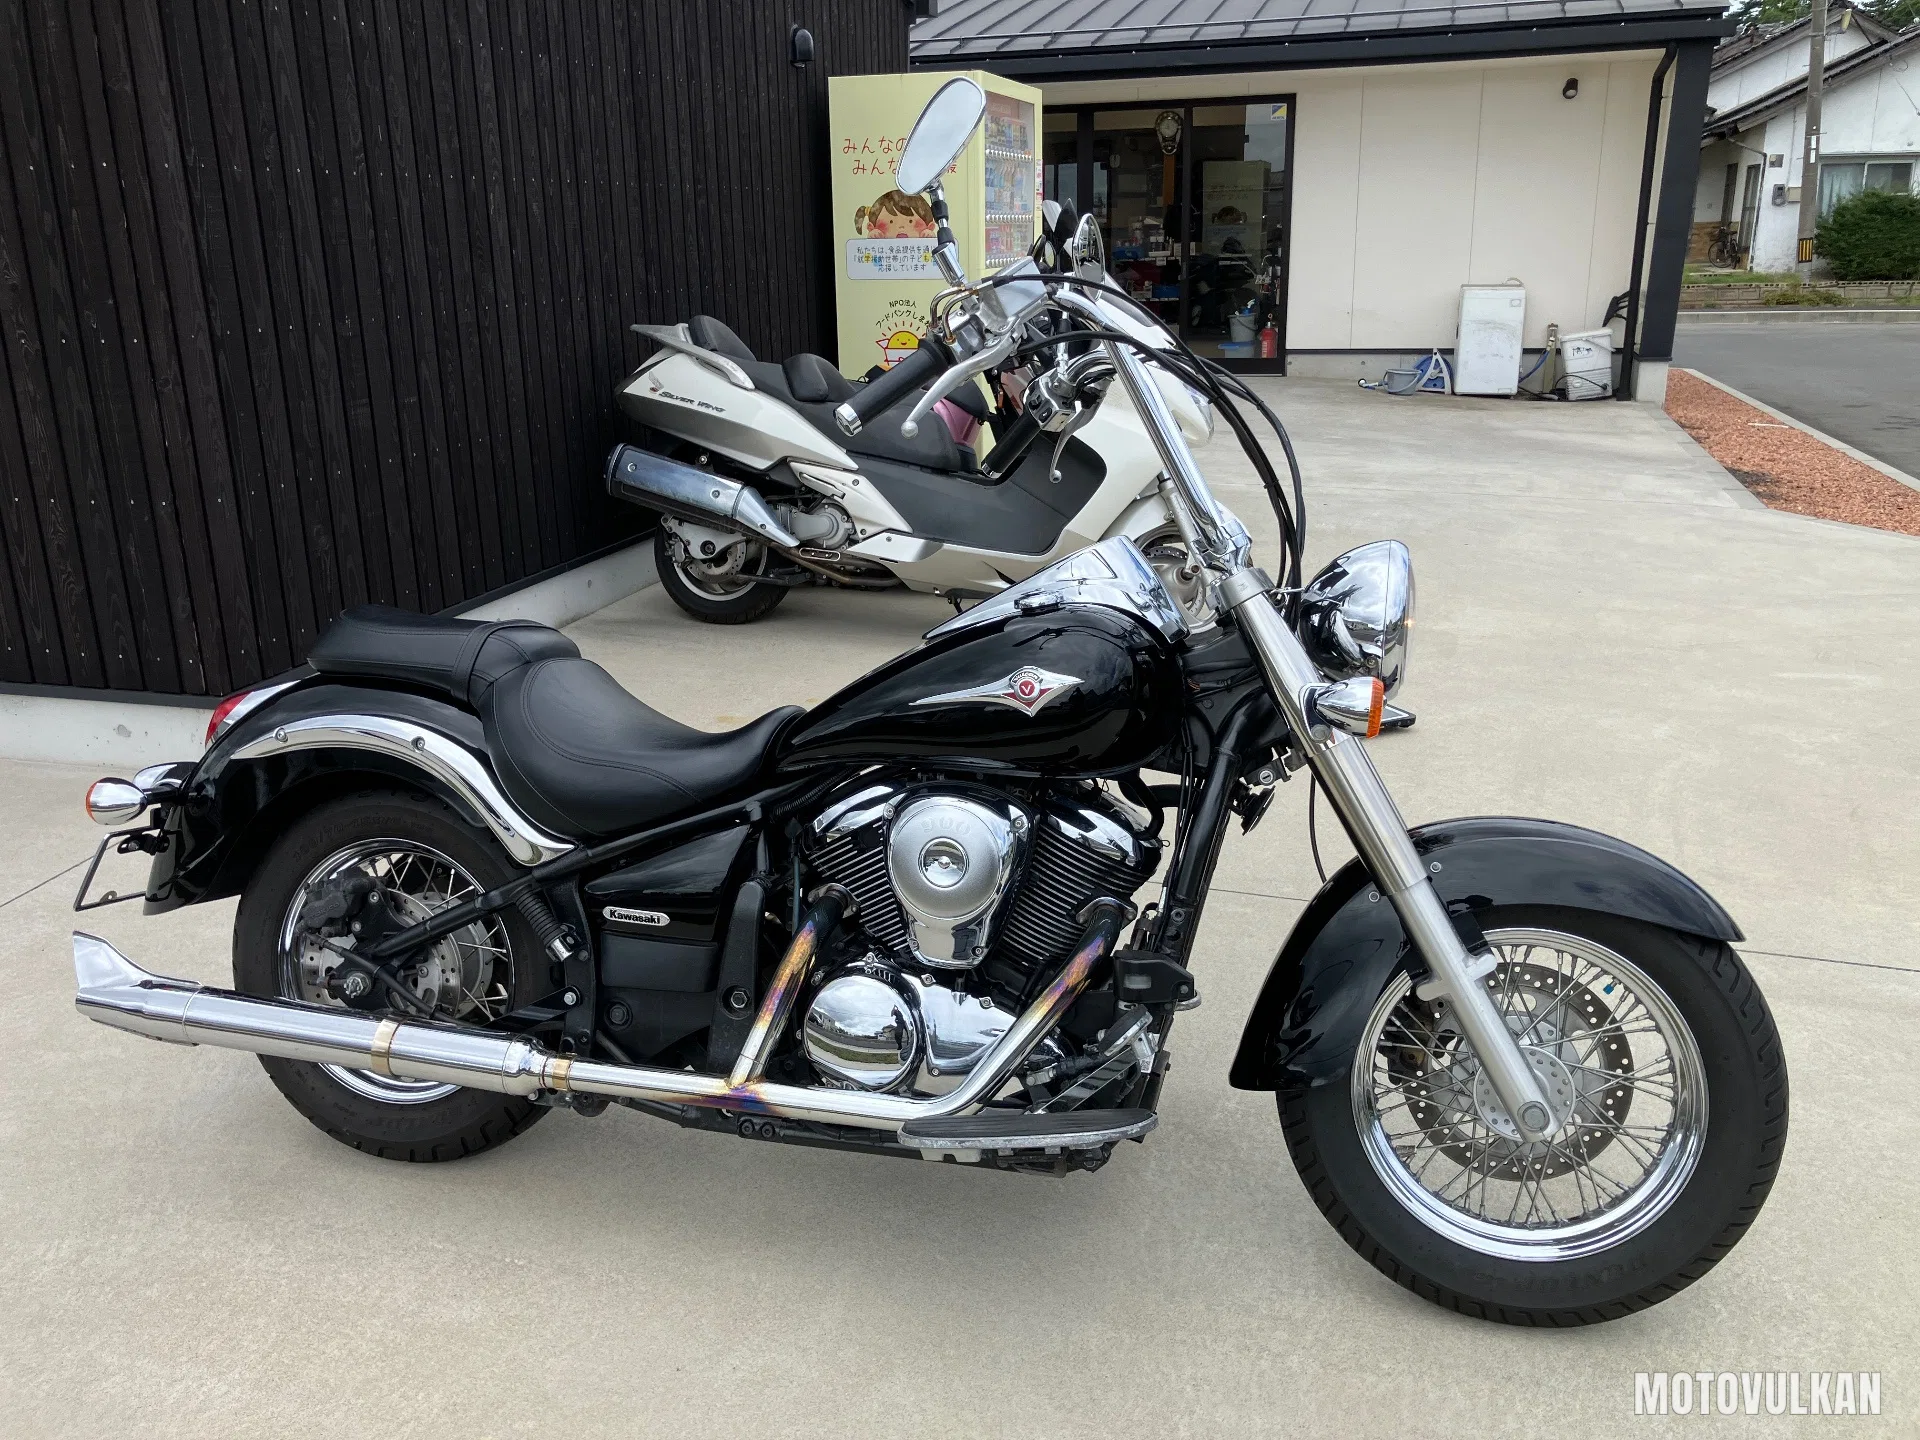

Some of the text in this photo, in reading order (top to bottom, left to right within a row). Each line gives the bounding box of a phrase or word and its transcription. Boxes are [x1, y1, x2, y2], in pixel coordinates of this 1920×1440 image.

[842, 136, 907, 154] みんなの
[889, 300, 917, 308] NPO法人
[1020, 684, 1032, 695] V
[609, 909, 661, 924] Kawasaki
